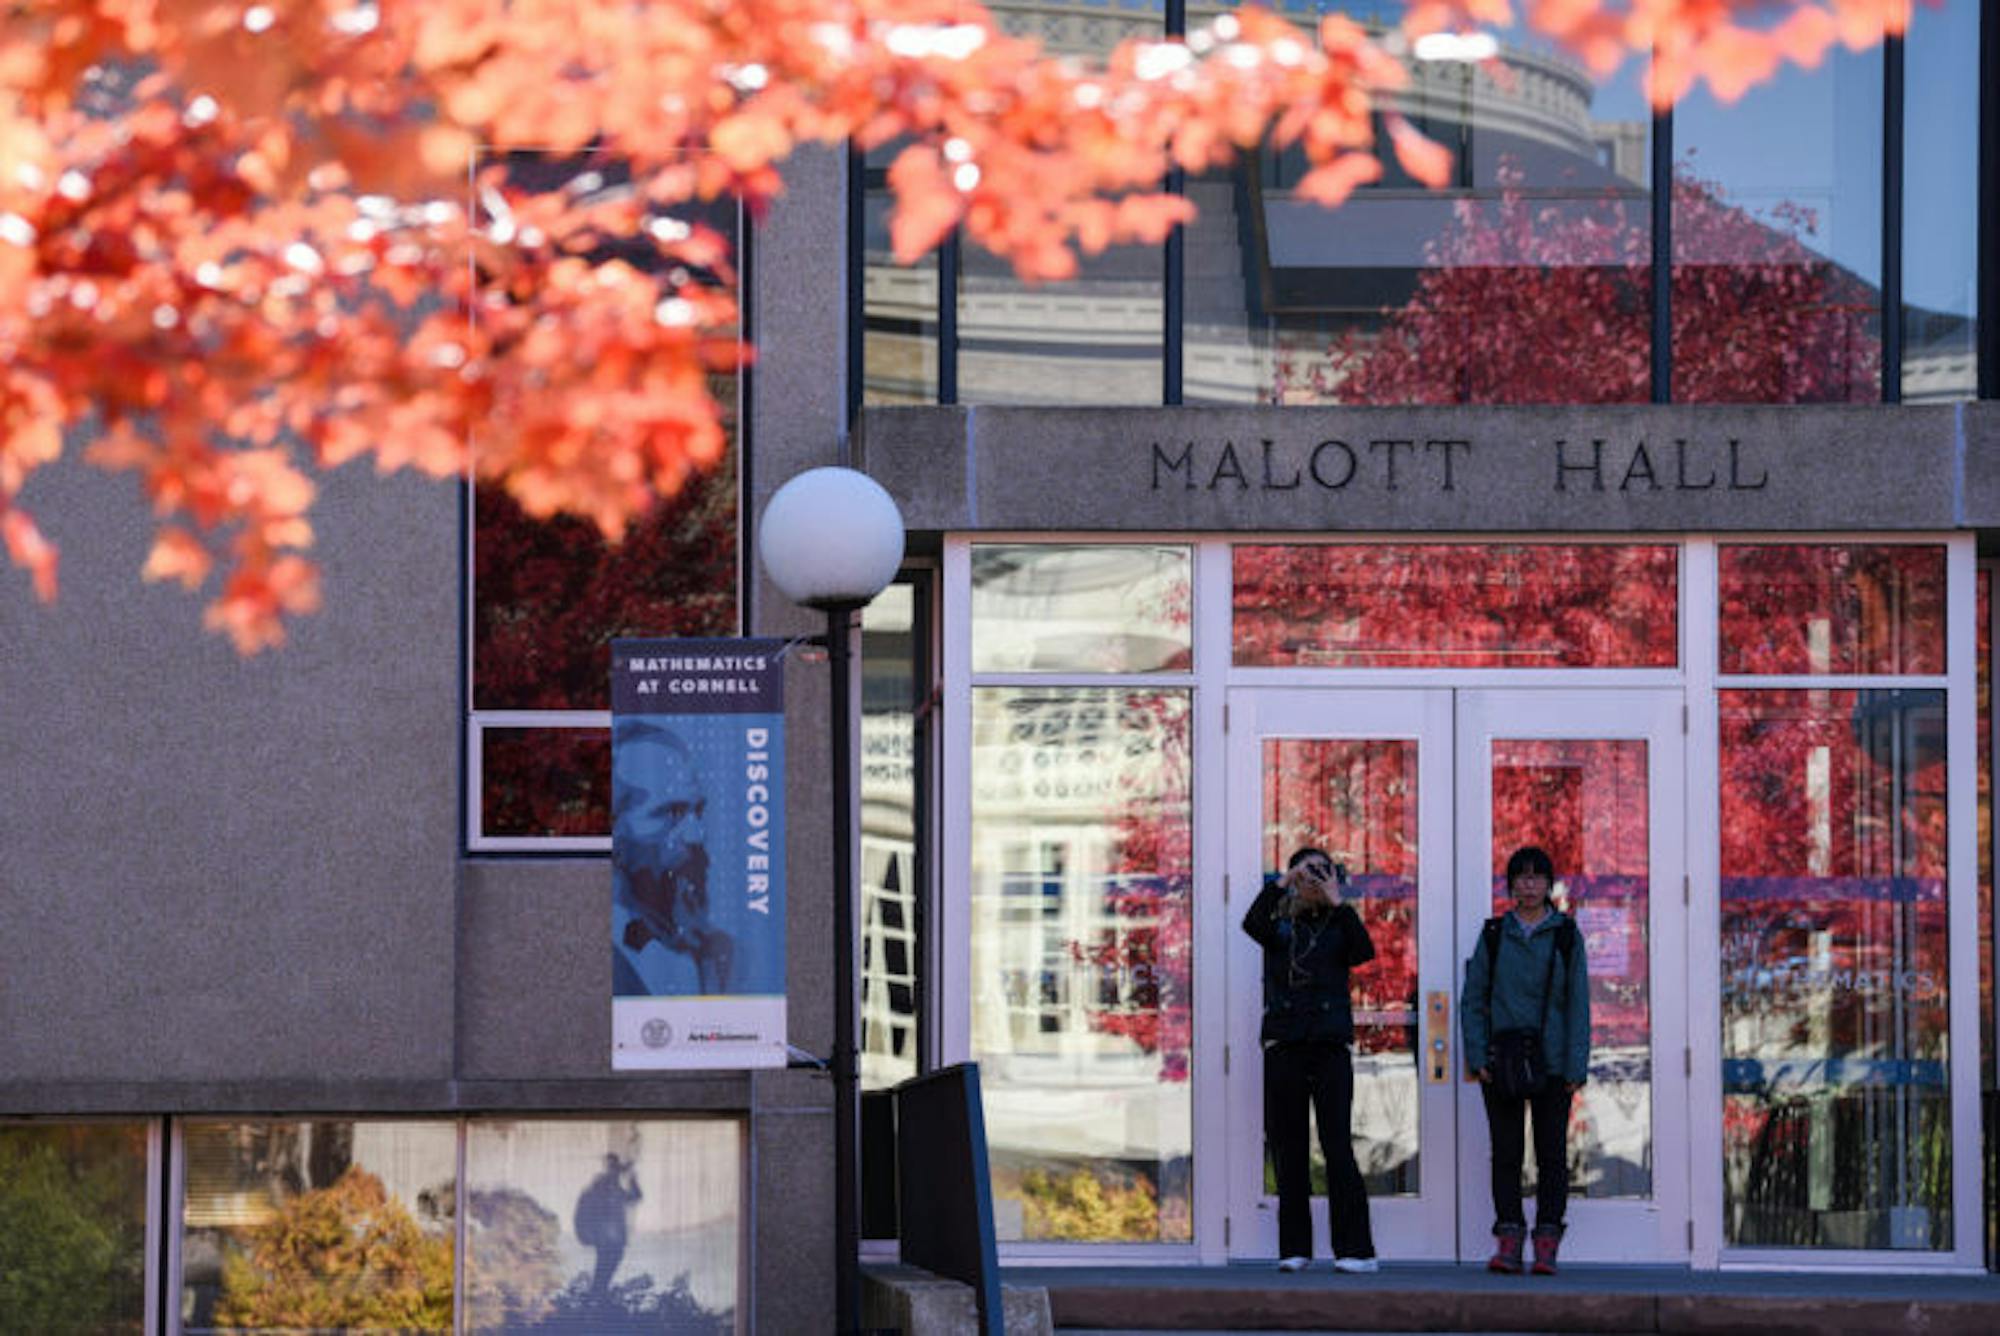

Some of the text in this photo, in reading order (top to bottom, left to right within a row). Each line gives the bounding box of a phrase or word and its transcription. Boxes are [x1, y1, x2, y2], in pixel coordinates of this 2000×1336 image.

[1151, 439, 1769, 490] MALOTT HALL
[629, 656, 767, 671] MATHEMATICS
[637, 678, 760, 693] AT CORNELL
[746, 728, 769, 914] DISCOVERY
